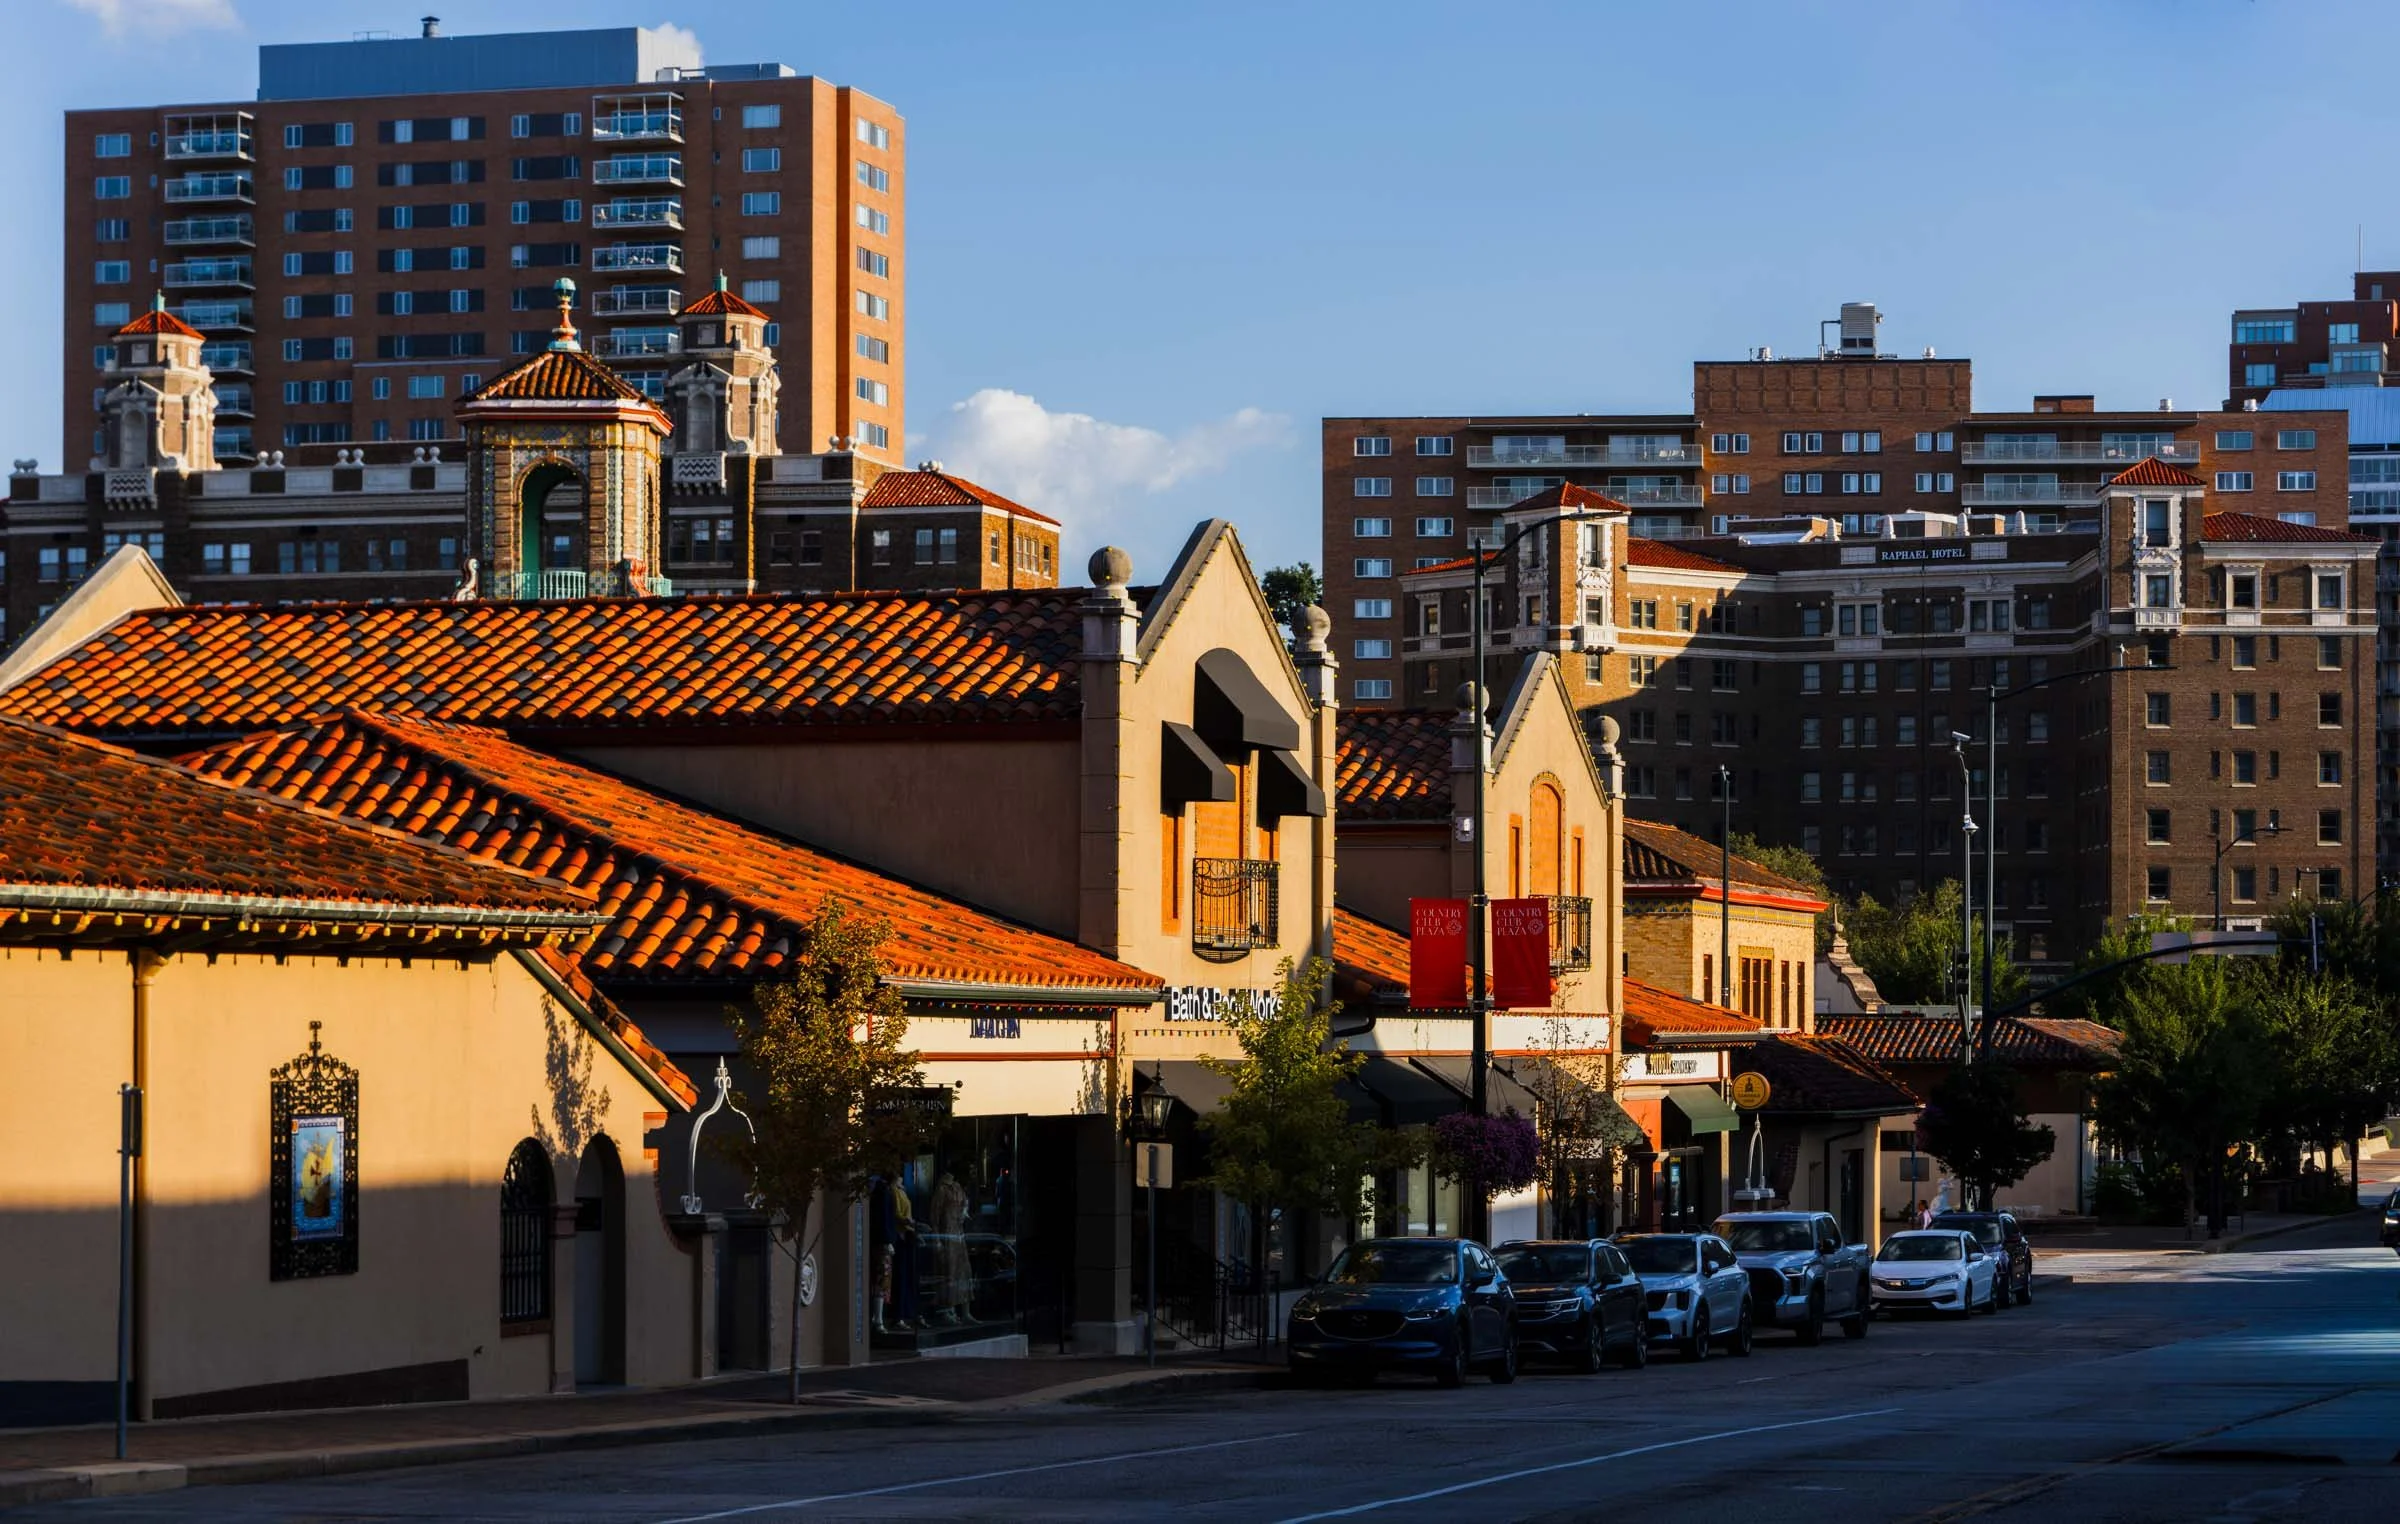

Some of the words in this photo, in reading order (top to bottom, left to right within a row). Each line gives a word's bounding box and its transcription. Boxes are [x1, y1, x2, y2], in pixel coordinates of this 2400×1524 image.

[1881, 550, 1928, 560] RAPHAEL
[1932, 548, 1965, 559] HOTEL
[1416, 908, 1461, 918] COUNTRY
[1496, 907, 1542, 917] COUNTRY
[1416, 917, 1441, 926] CLUB
[1496, 917, 1522, 927] CLUB
[1416, 926, 1445, 936] PLAZA
[1497, 926, 1527, 936] PLAZA
[1170, 986, 1200, 1020] Bath
[1202, 987, 1212, 1020] &
